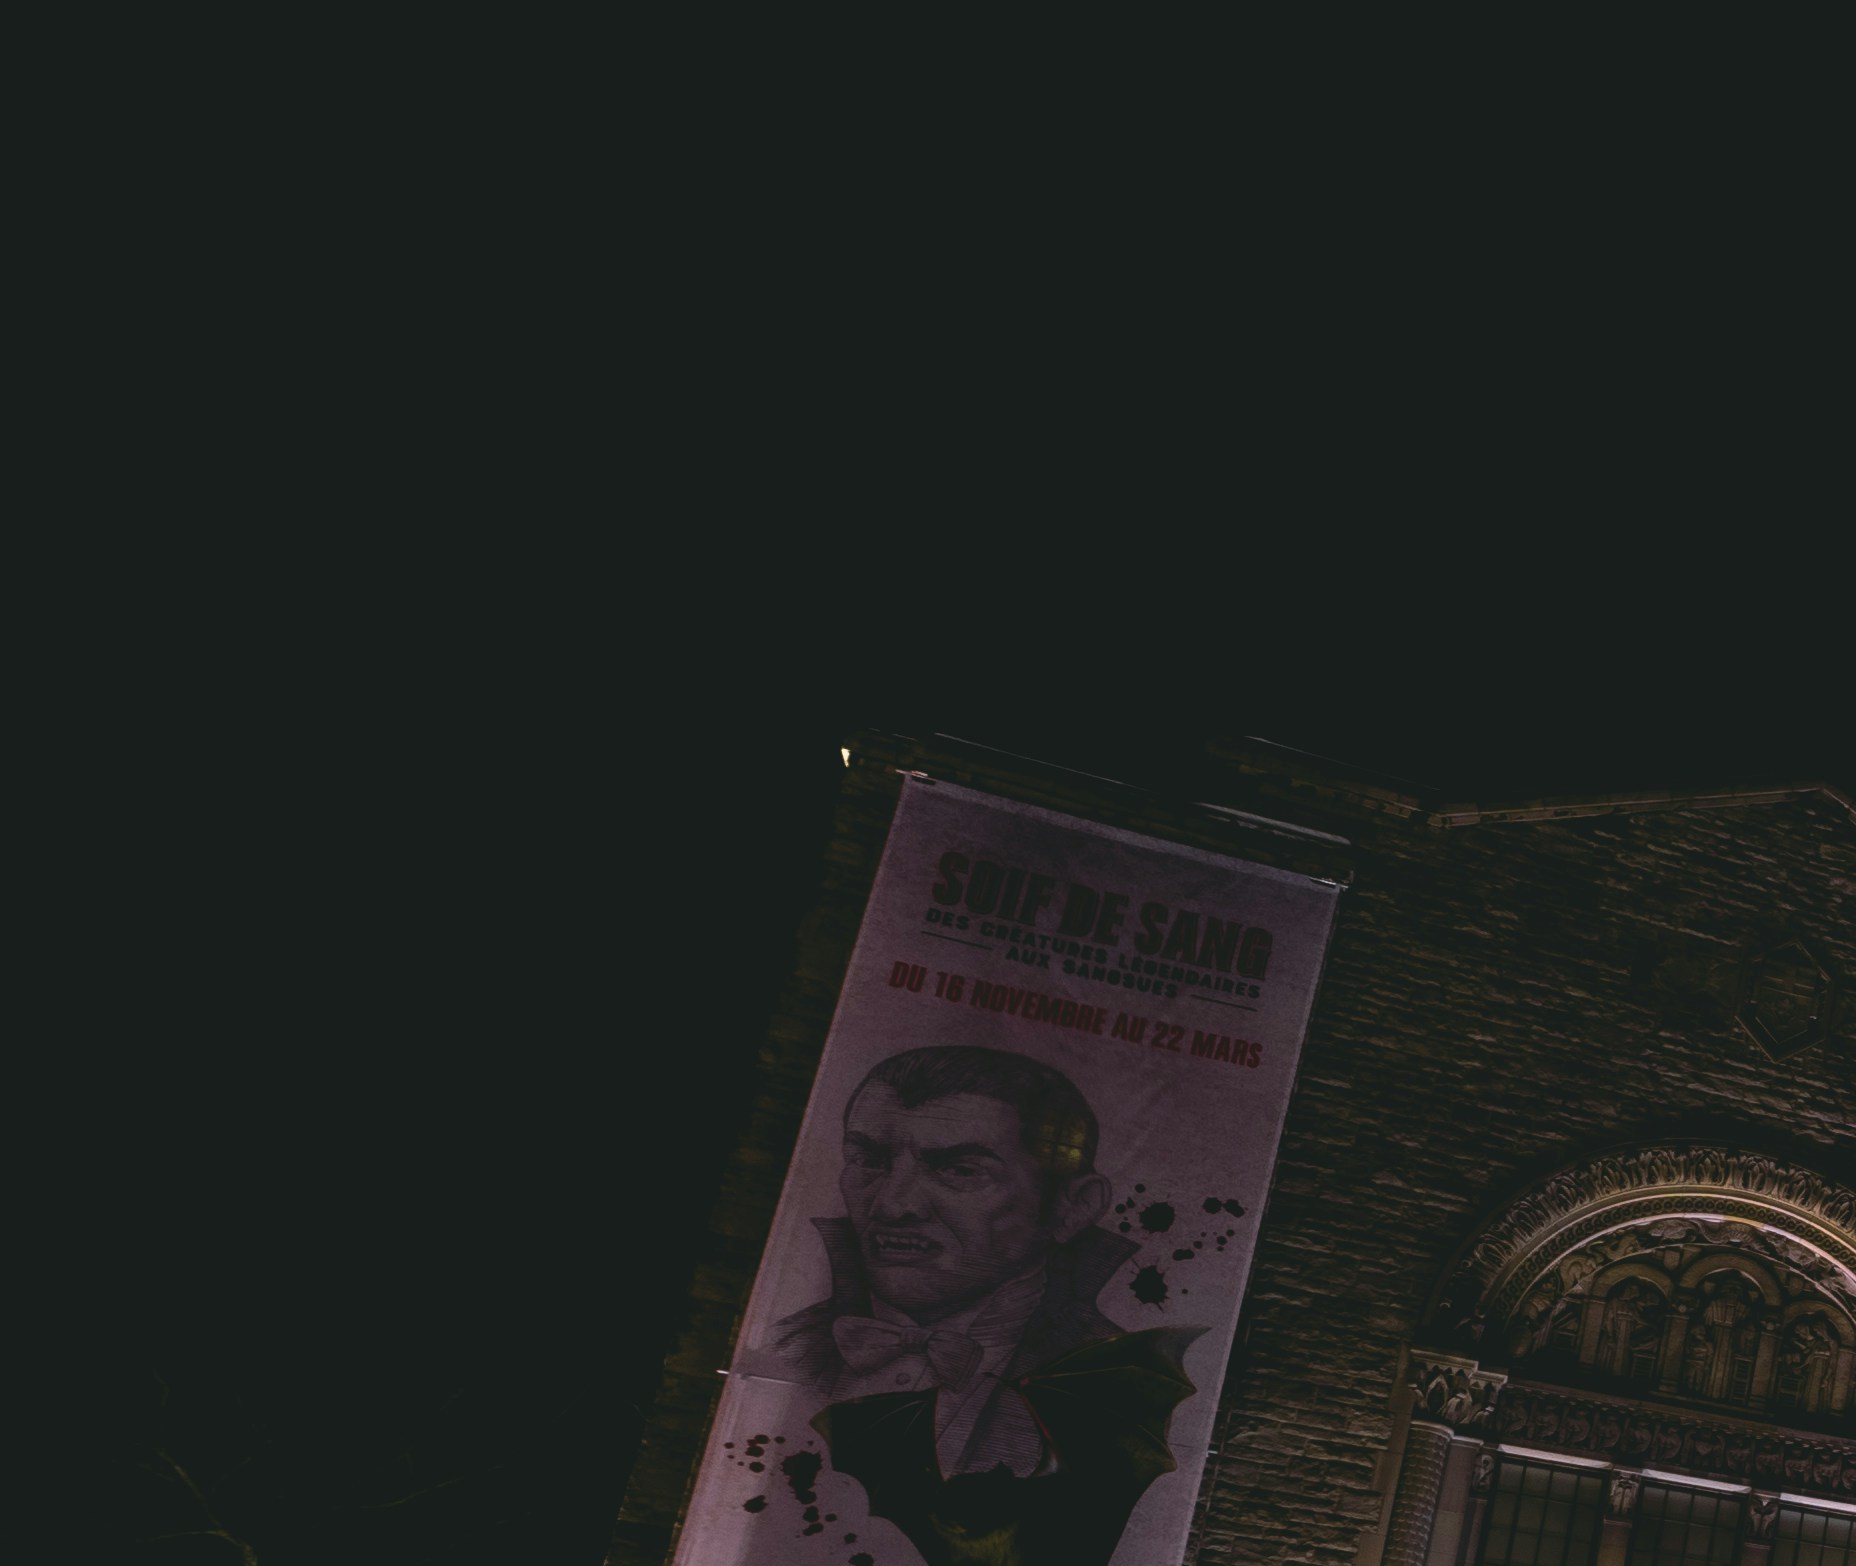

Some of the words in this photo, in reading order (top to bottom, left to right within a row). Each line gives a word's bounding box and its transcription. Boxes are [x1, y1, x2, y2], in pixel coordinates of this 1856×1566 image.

[925, 907, 970, 931] DES
[932, 851, 1056, 927] SOIF
[1057, 882, 1131, 947] DE
[1134, 901, 1274, 981] SANG
[1006, 946, 1051, 970] AUX
[1062, 958, 1179, 999] SANGSUES
[888, 960, 928, 994] DU
[934, 970, 967, 1003] 16
[969, 979, 1109, 1036] NOVEMBRE
[1111, 1012, 1147, 1044] AU
[1150, 1020, 1186, 1054] 22
[1190, 1030, 1264, 1069] MARS
